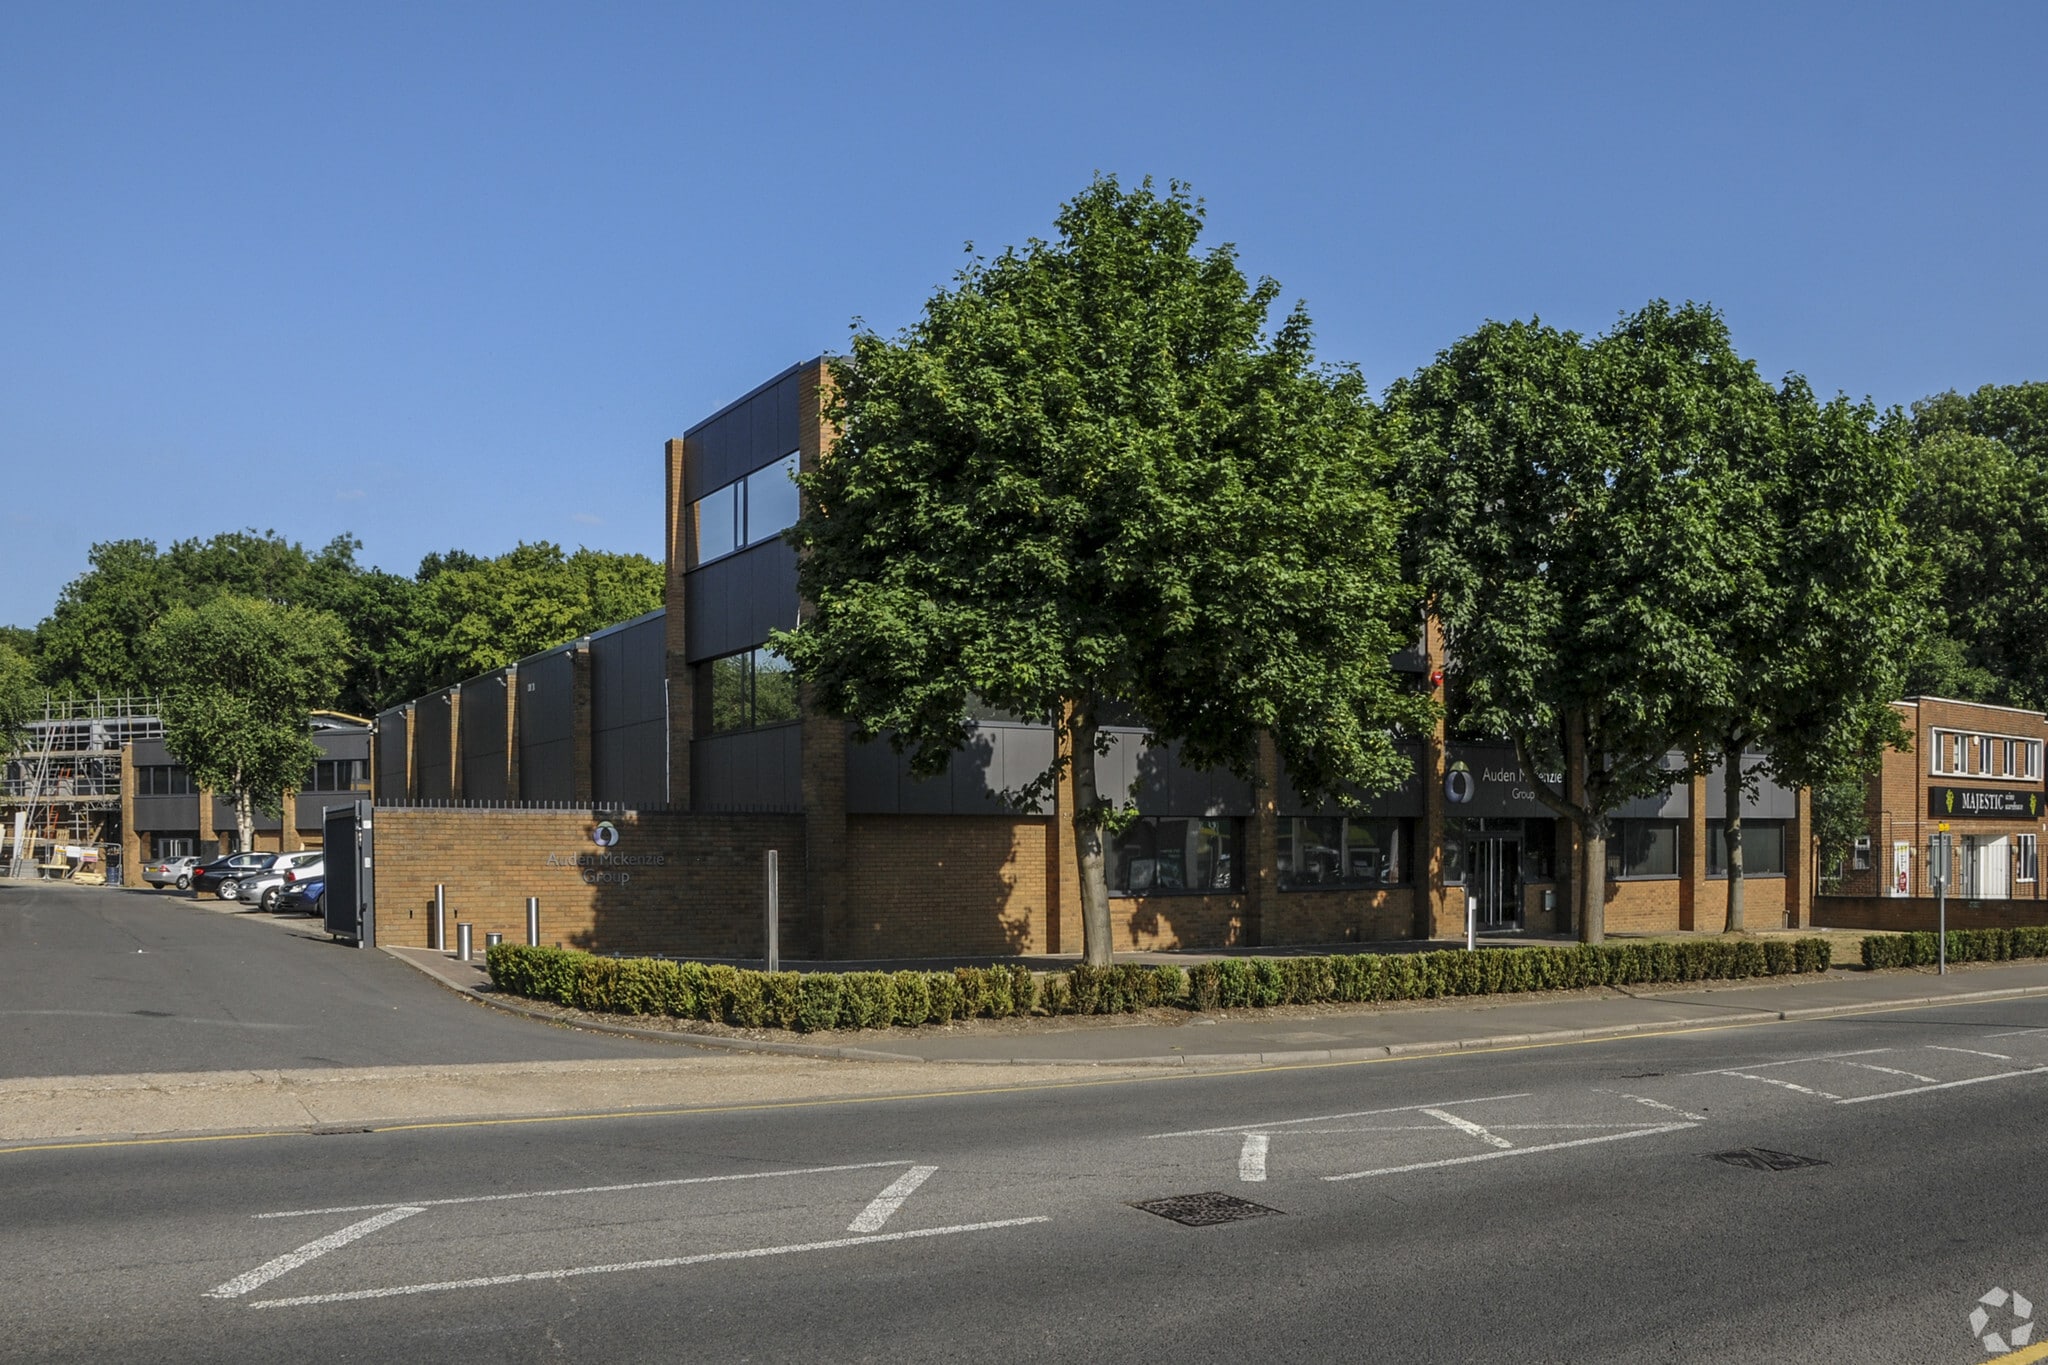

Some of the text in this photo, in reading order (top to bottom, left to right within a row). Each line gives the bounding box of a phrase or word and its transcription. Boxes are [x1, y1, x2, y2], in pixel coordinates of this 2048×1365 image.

[1482, 767, 1516, 782] Auden
[1511, 788, 1535, 801] Group
[1962, 792, 2004, 814] MAJESTIC
[546, 852, 594, 866] Auden
[583, 868, 630, 885] Group
